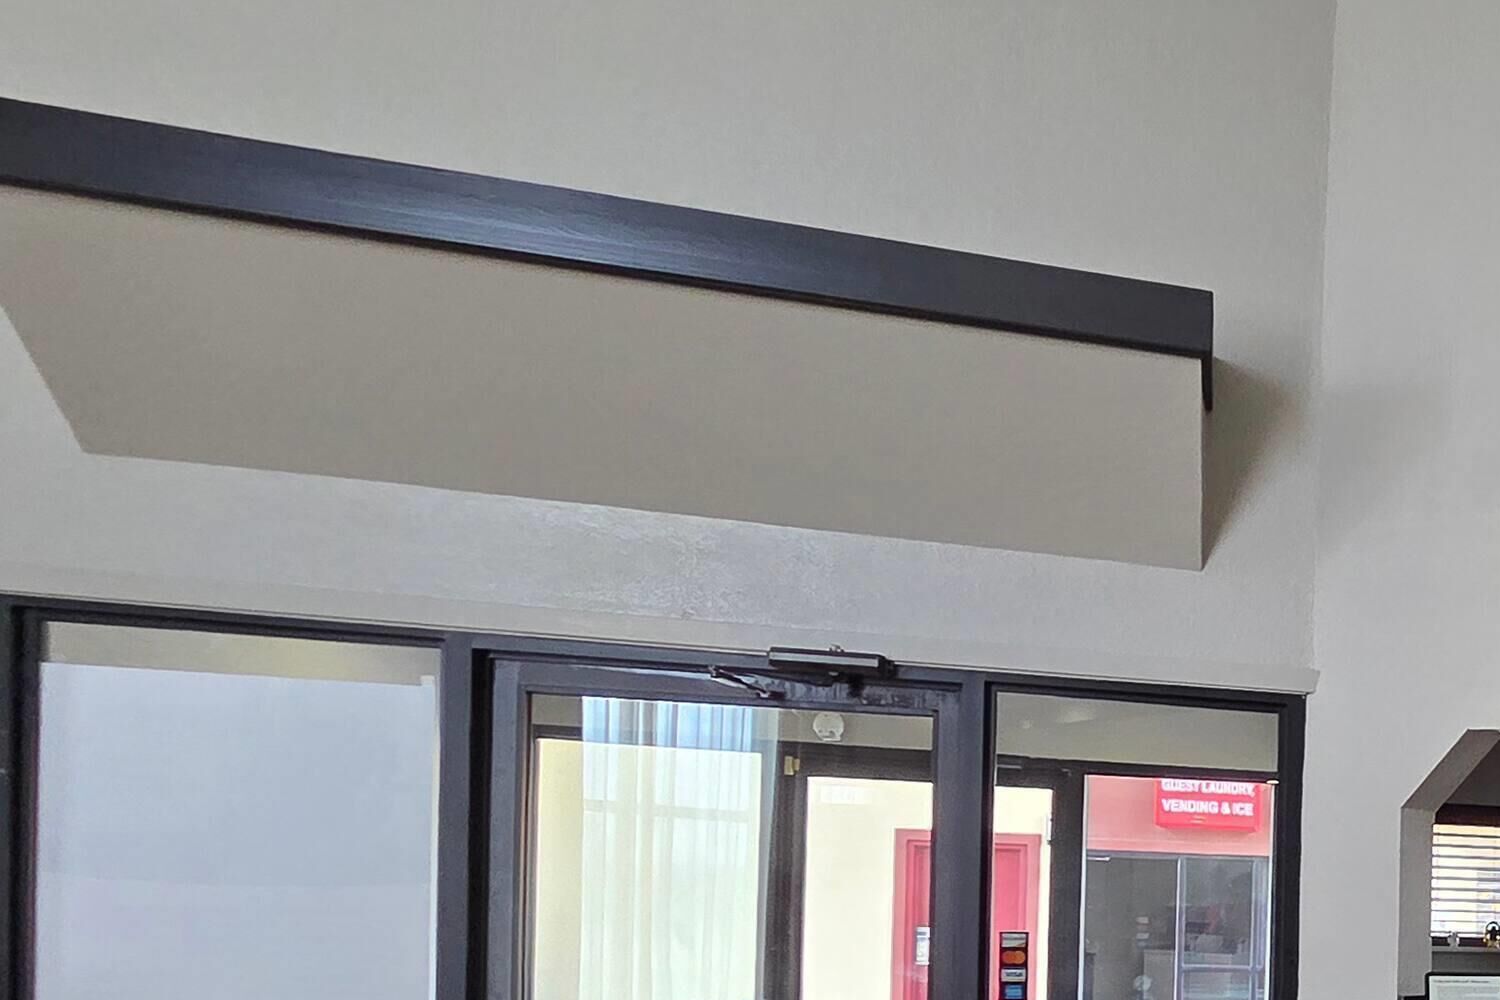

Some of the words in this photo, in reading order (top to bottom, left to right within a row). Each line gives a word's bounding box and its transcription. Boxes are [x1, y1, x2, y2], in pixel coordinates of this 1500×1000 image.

[1162, 799, 1218, 813] VENDING
[1220, 802, 1231, 815] &
[1232, 803, 1254, 816] ICE
